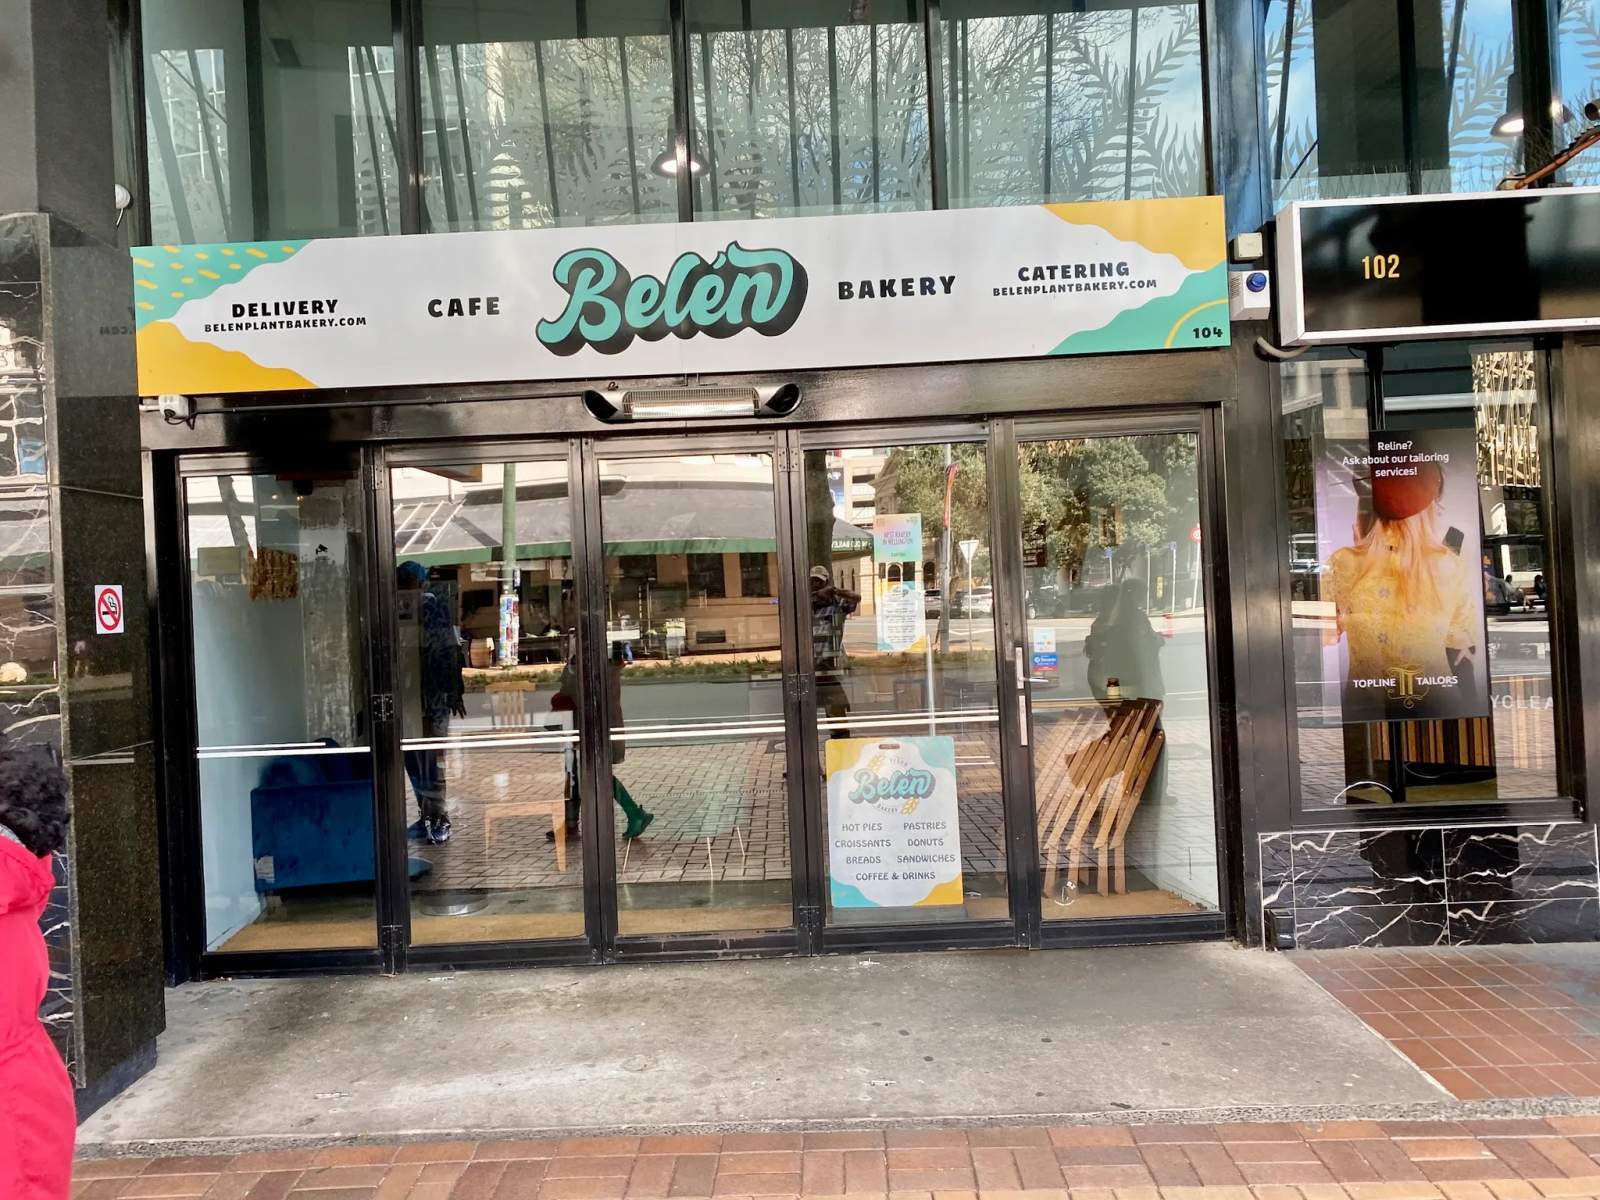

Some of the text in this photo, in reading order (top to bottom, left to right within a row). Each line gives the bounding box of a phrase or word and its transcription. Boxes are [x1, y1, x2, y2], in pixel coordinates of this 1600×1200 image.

[1017, 261, 1130, 282] CATERING
[1362, 254, 1400, 279] 102
[838, 275, 956, 300] BAKERY
[992, 279, 1158, 297] BELENPLANTBAKERY.COM
[536, 240, 808, 357] Belén
[231, 299, 338, 318] DELIVERY
[427, 296, 500, 318] CAFE
[204, 317, 367, 333] BELENPLANTBAKERY.COM
[1193, 327, 1223, 340] 104
[1377, 440, 1413, 451] Reline?
[1342, 452, 1450, 466] Ask about our tailoring
[1375, 467, 1418, 477] services!
[1353, 678, 1396, 689] TOPLINE
[1416, 675, 1458, 686] TAILORS
[842, 823, 882, 832] HOT PIES
[903, 821, 946, 831] PASTRIES
[835, 839, 892, 848] CROISSANTS
[907, 838, 944, 847] DONUTS
[846, 855, 881, 865] BREADS
[897, 854, 956, 863] SANDWICHES
[855, 871, 936, 881] COFFEE & DRINKS
